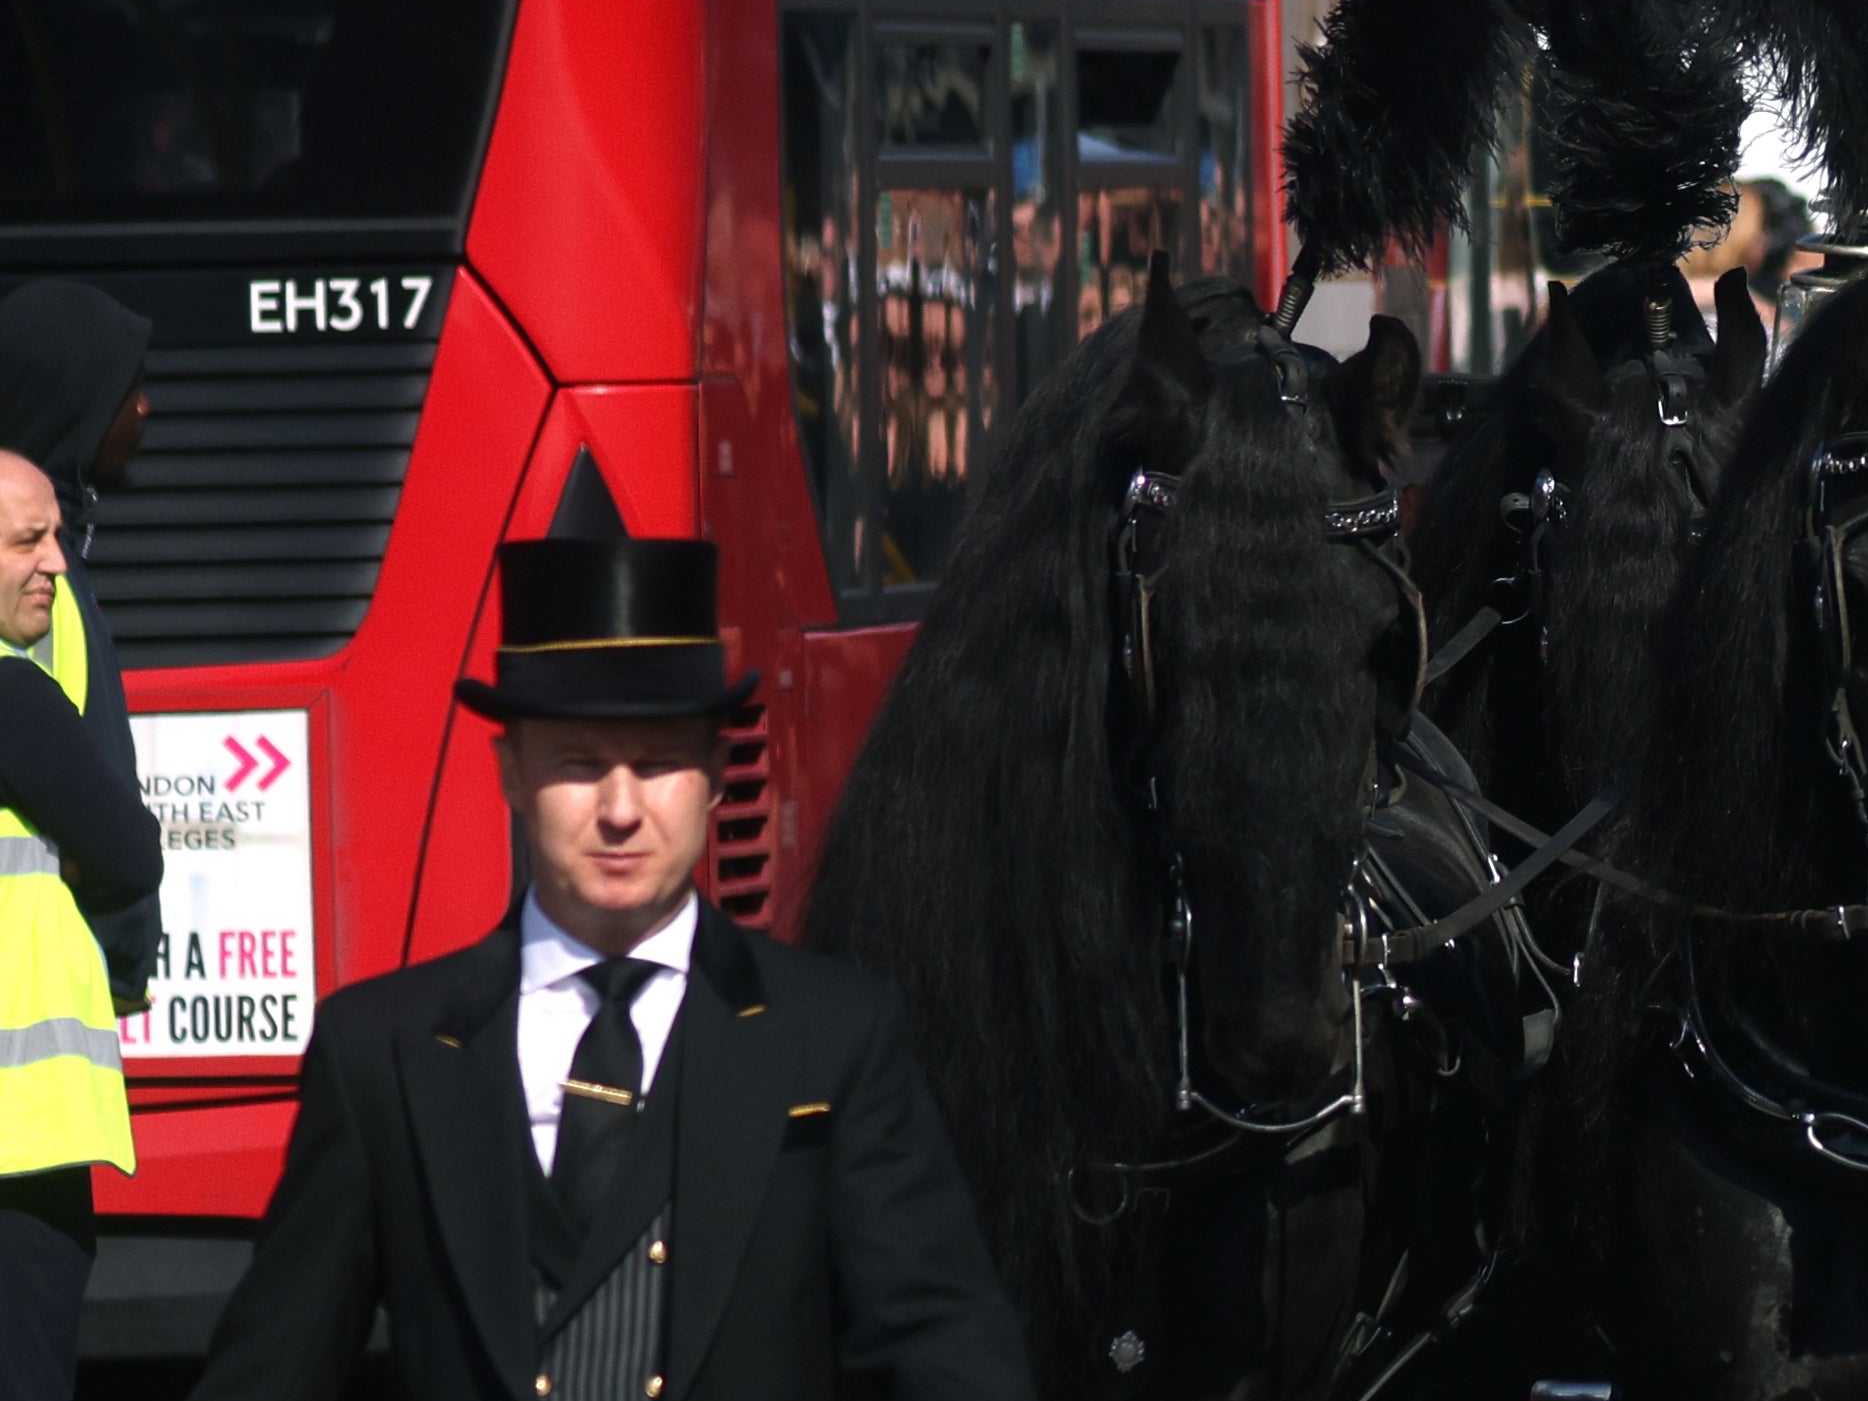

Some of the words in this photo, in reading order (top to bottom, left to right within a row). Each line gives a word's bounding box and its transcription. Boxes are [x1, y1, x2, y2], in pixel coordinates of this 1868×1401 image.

[249, 276, 433, 333] EH317
[139, 773, 215, 797] NDON
[199, 800, 267, 824] EAST
[161, 828, 236, 852] EGES
[184, 931, 206, 980] A
[217, 929, 297, 980] FREE
[168, 993, 299, 1045] COURSE
